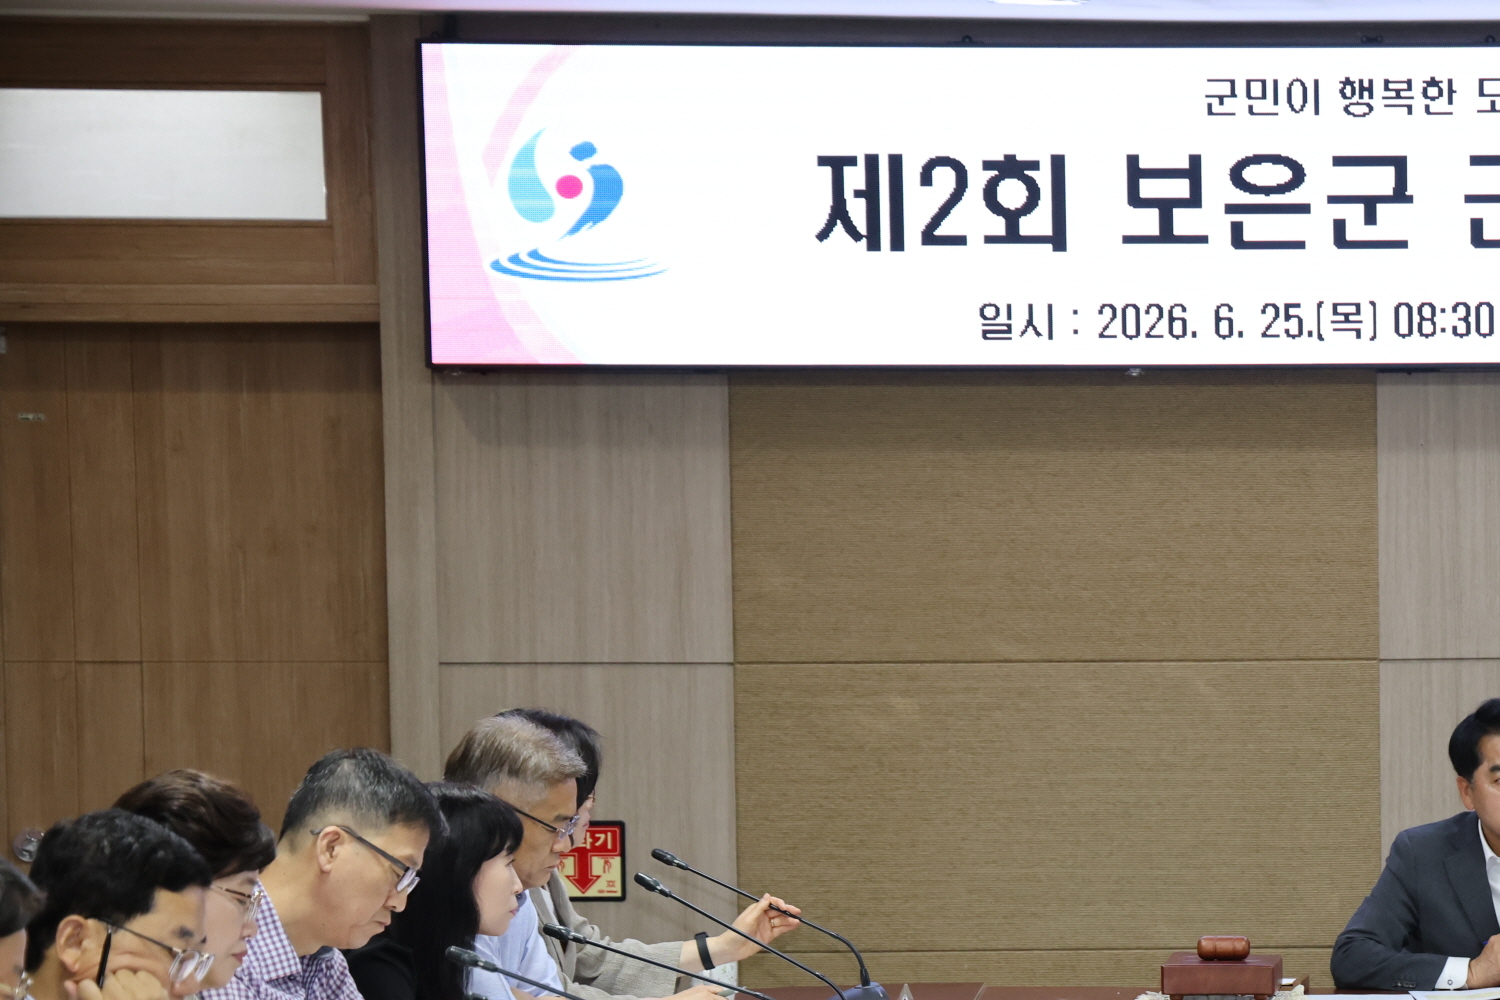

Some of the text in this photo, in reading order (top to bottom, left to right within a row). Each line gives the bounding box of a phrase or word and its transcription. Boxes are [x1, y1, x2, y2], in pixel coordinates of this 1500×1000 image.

[1204, 78, 1320, 116] 군민이
[1338, 76, 1457, 118] 행복한
[815, 153, 1068, 253] 제2회
[1121, 153, 1414, 250] 보은군
[979, 302, 1054, 341] 일시
[1098, 303, 1197, 341] 2026.
[1214, 303, 1244, 341] 6.
[1393, 301, 1495, 339] 08:30
